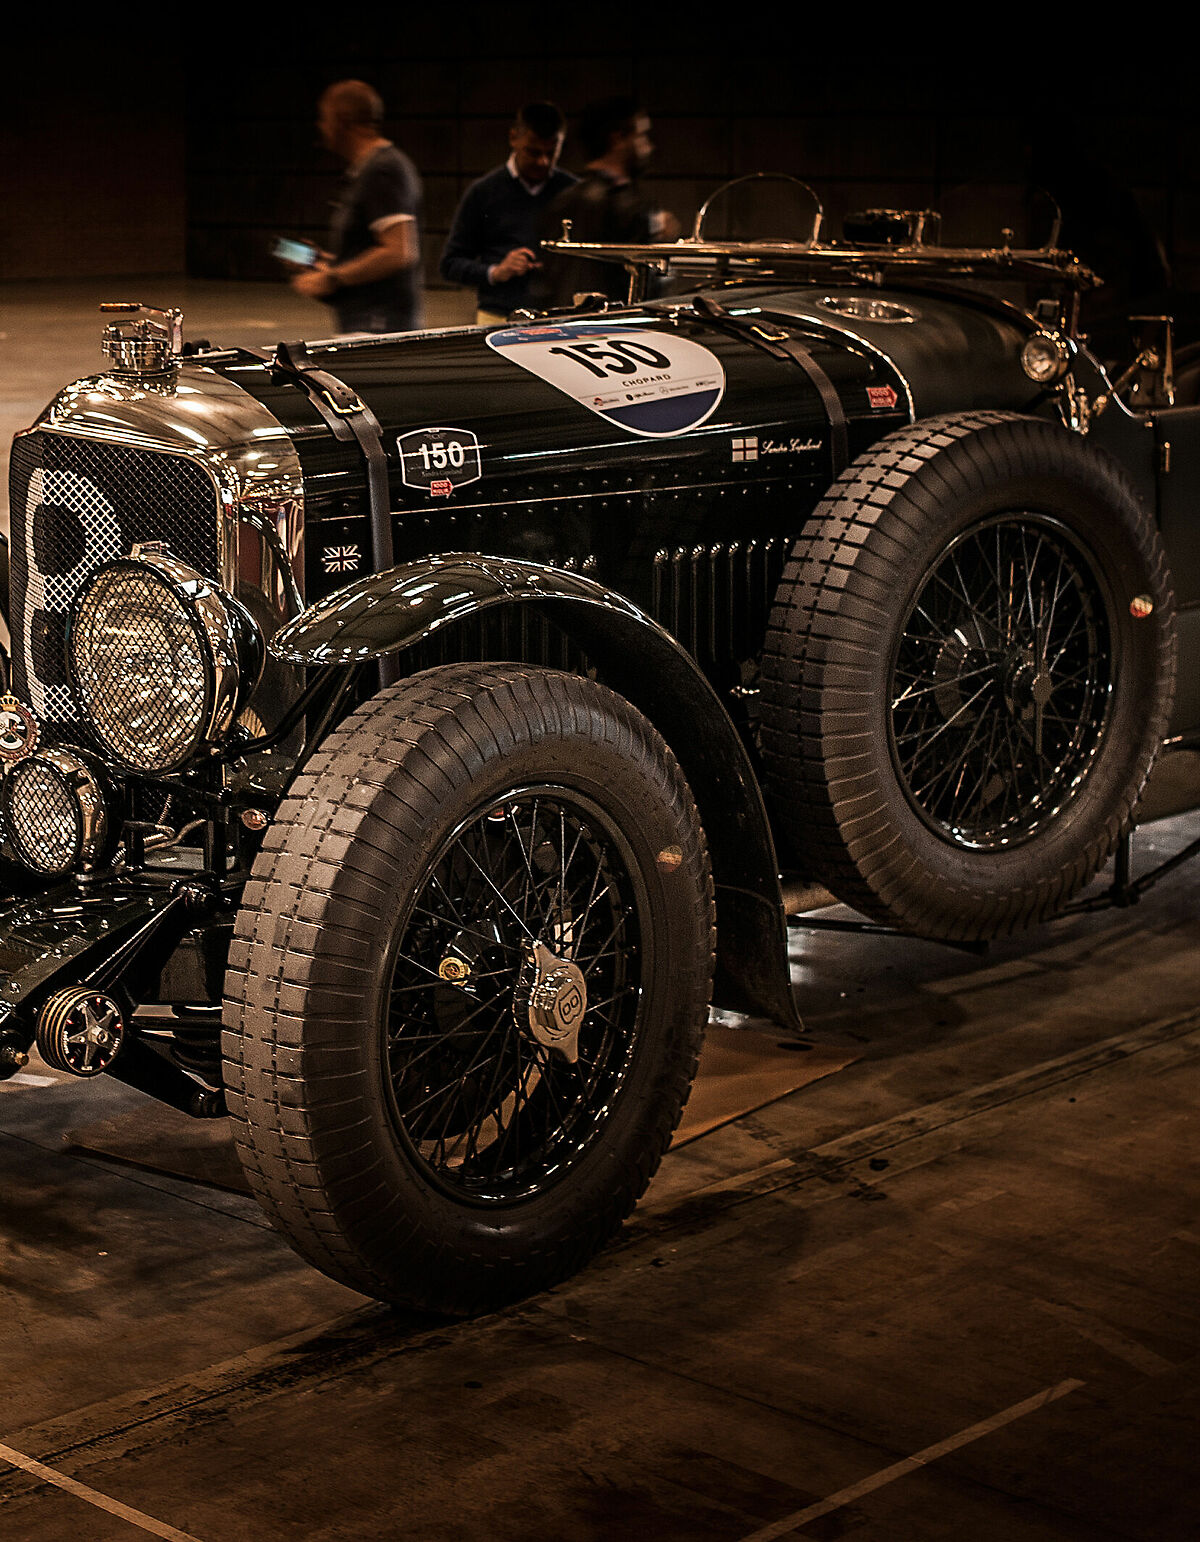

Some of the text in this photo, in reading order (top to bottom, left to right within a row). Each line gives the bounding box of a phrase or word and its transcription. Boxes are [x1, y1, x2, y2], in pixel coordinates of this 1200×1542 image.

[549, 339, 671, 378] 150
[622, 373, 672, 388] CHOPARD
[418, 440, 465, 470] 150
